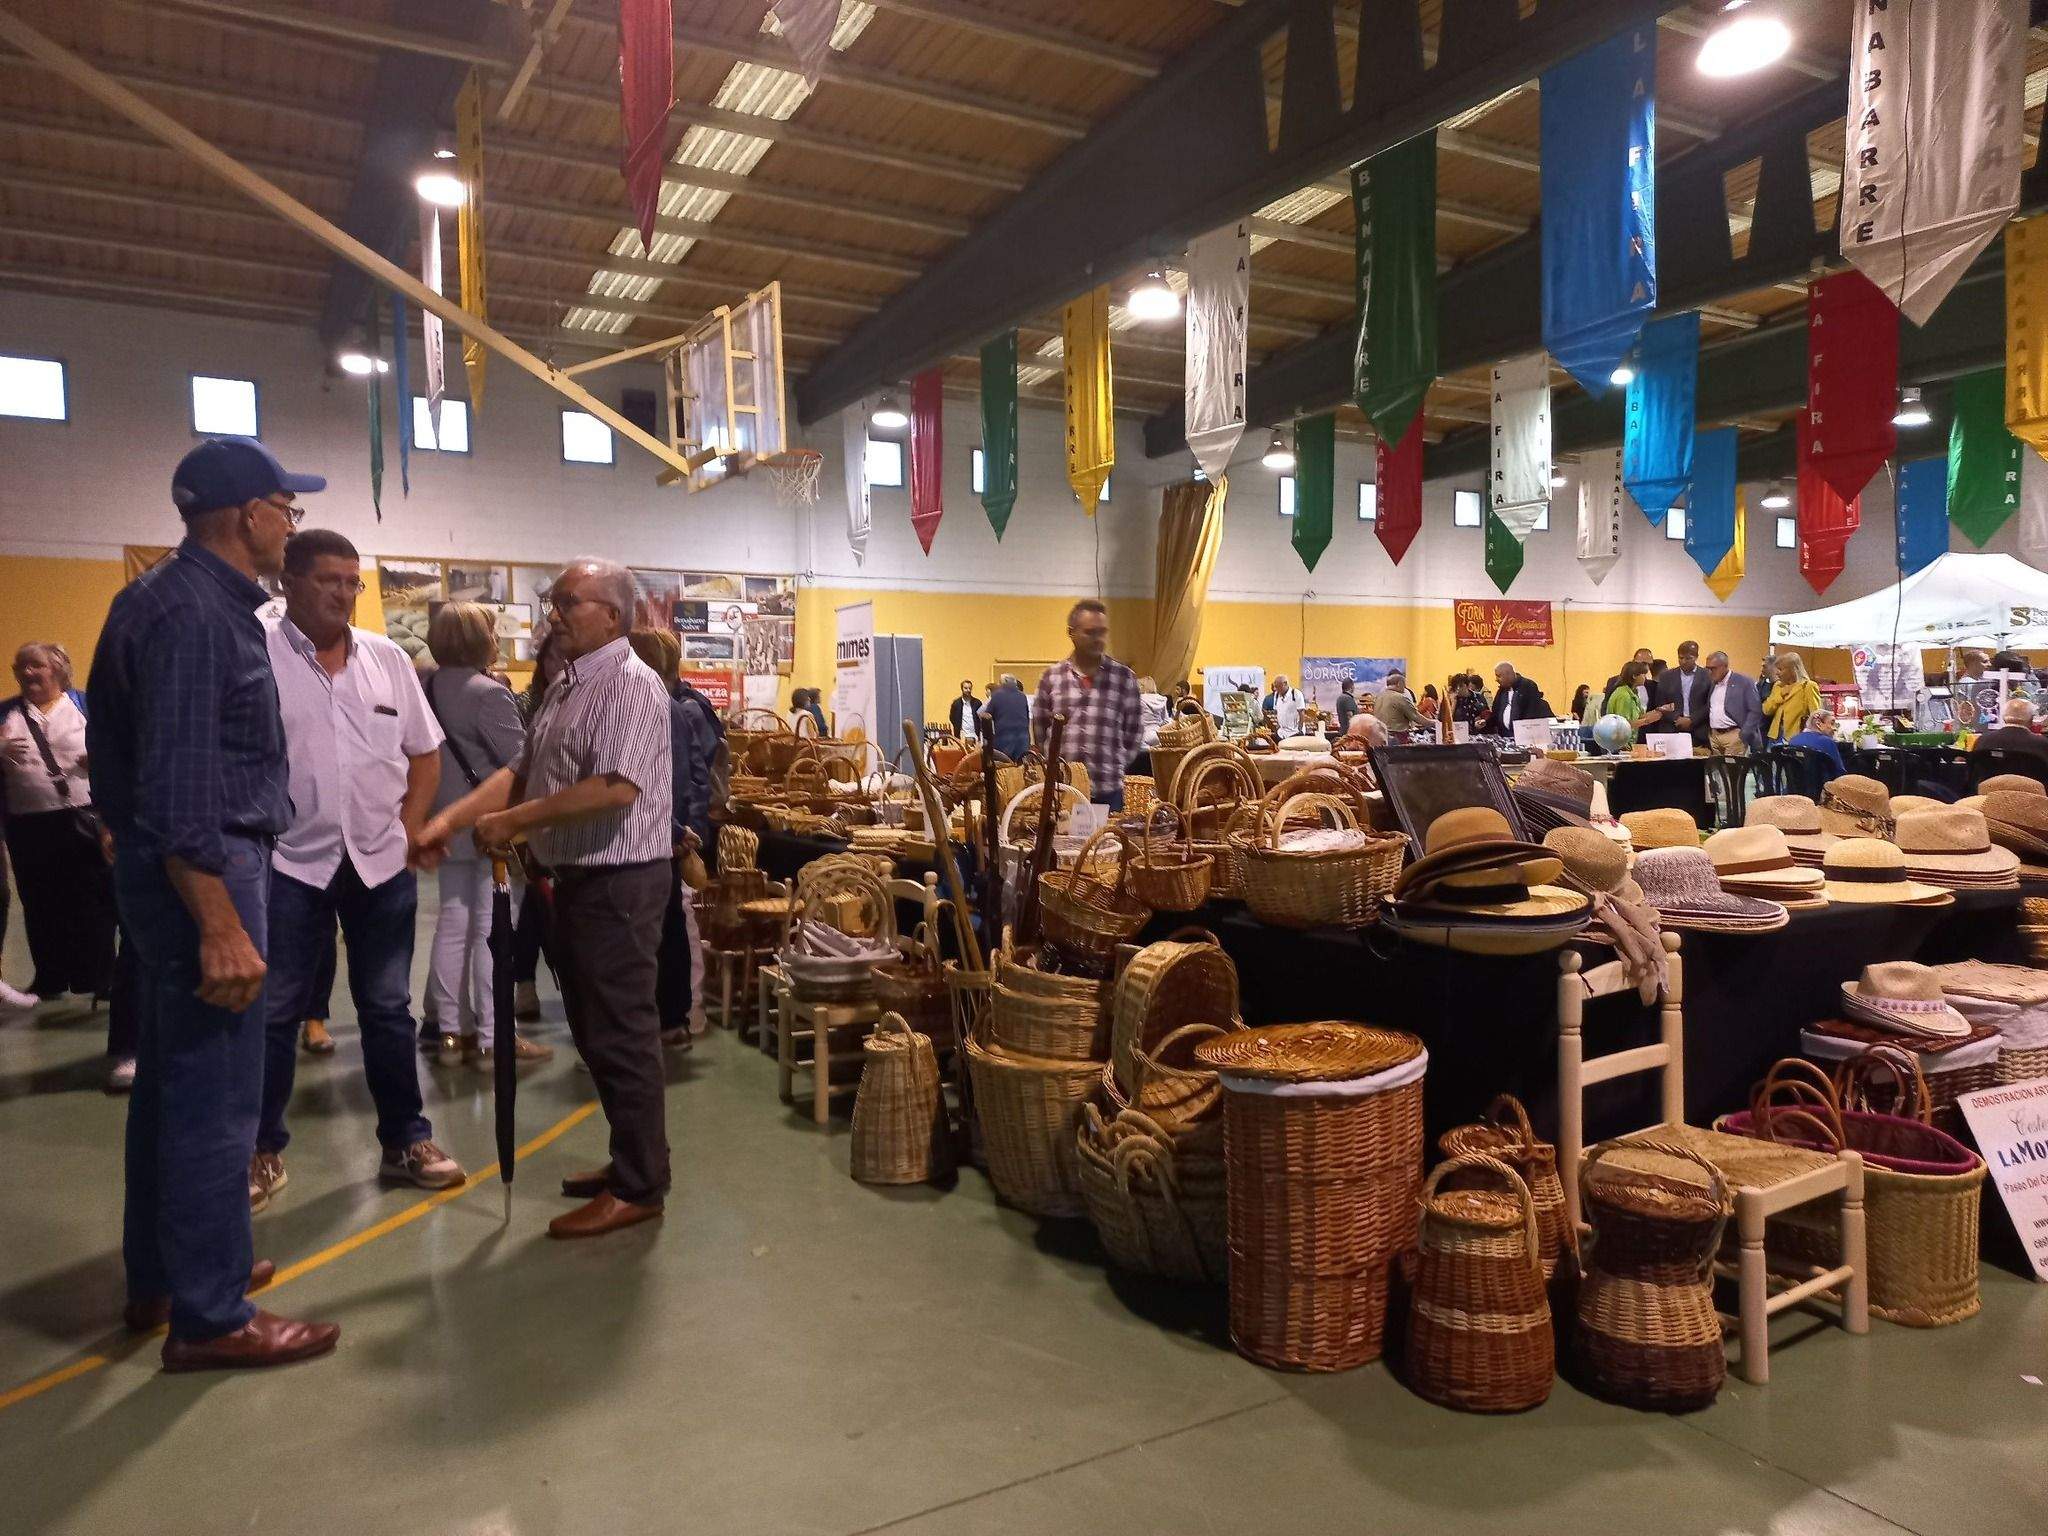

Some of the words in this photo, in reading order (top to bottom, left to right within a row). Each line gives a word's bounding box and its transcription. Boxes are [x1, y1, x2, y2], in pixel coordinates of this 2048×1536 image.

[1237, 223, 1246, 272] LA
[1813, 286, 1823, 326] LA
[1234, 306, 1245, 420] FIRA
[1494, 369, 1502, 403] LA
[1811, 354, 1824, 453] FIRA
[1494, 425, 1504, 504] FIRA
[2004, 446, 2017, 504] IRA
